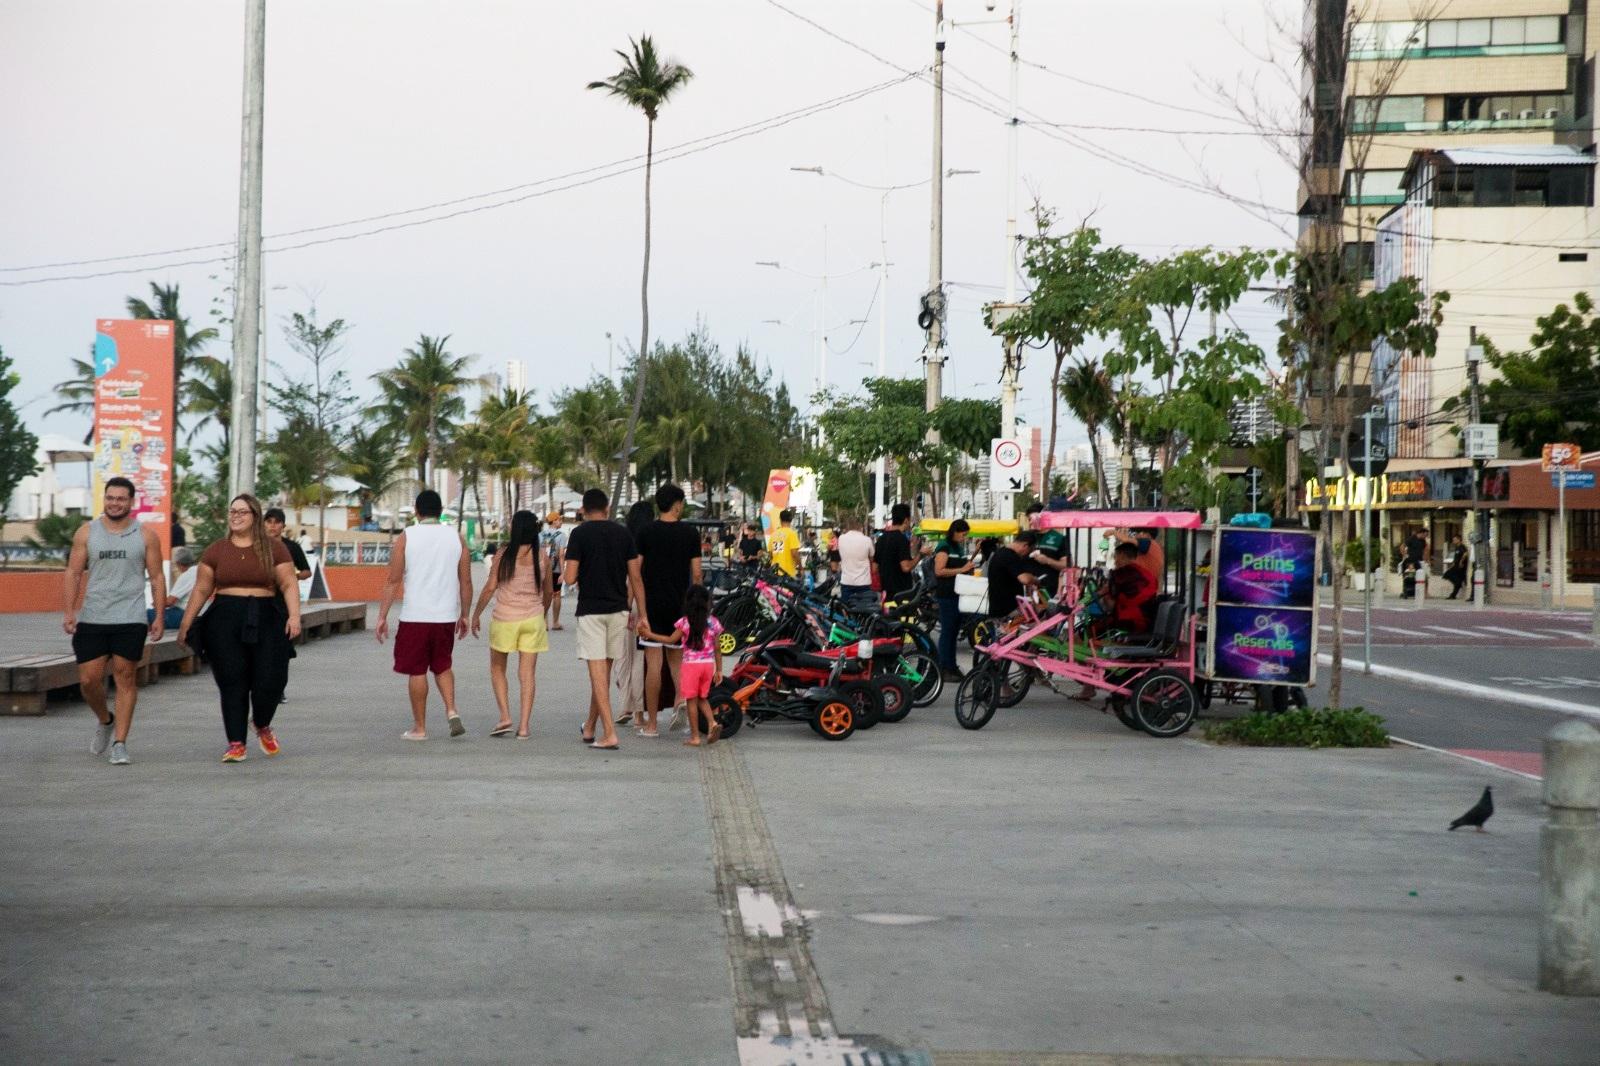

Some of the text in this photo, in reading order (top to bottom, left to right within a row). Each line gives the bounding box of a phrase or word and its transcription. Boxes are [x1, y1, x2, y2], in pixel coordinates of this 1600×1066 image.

[99, 550, 127, 560] DIESEL
[1242, 553, 1295, 572] Patins
[1233, 632, 1294, 650] Reservas
